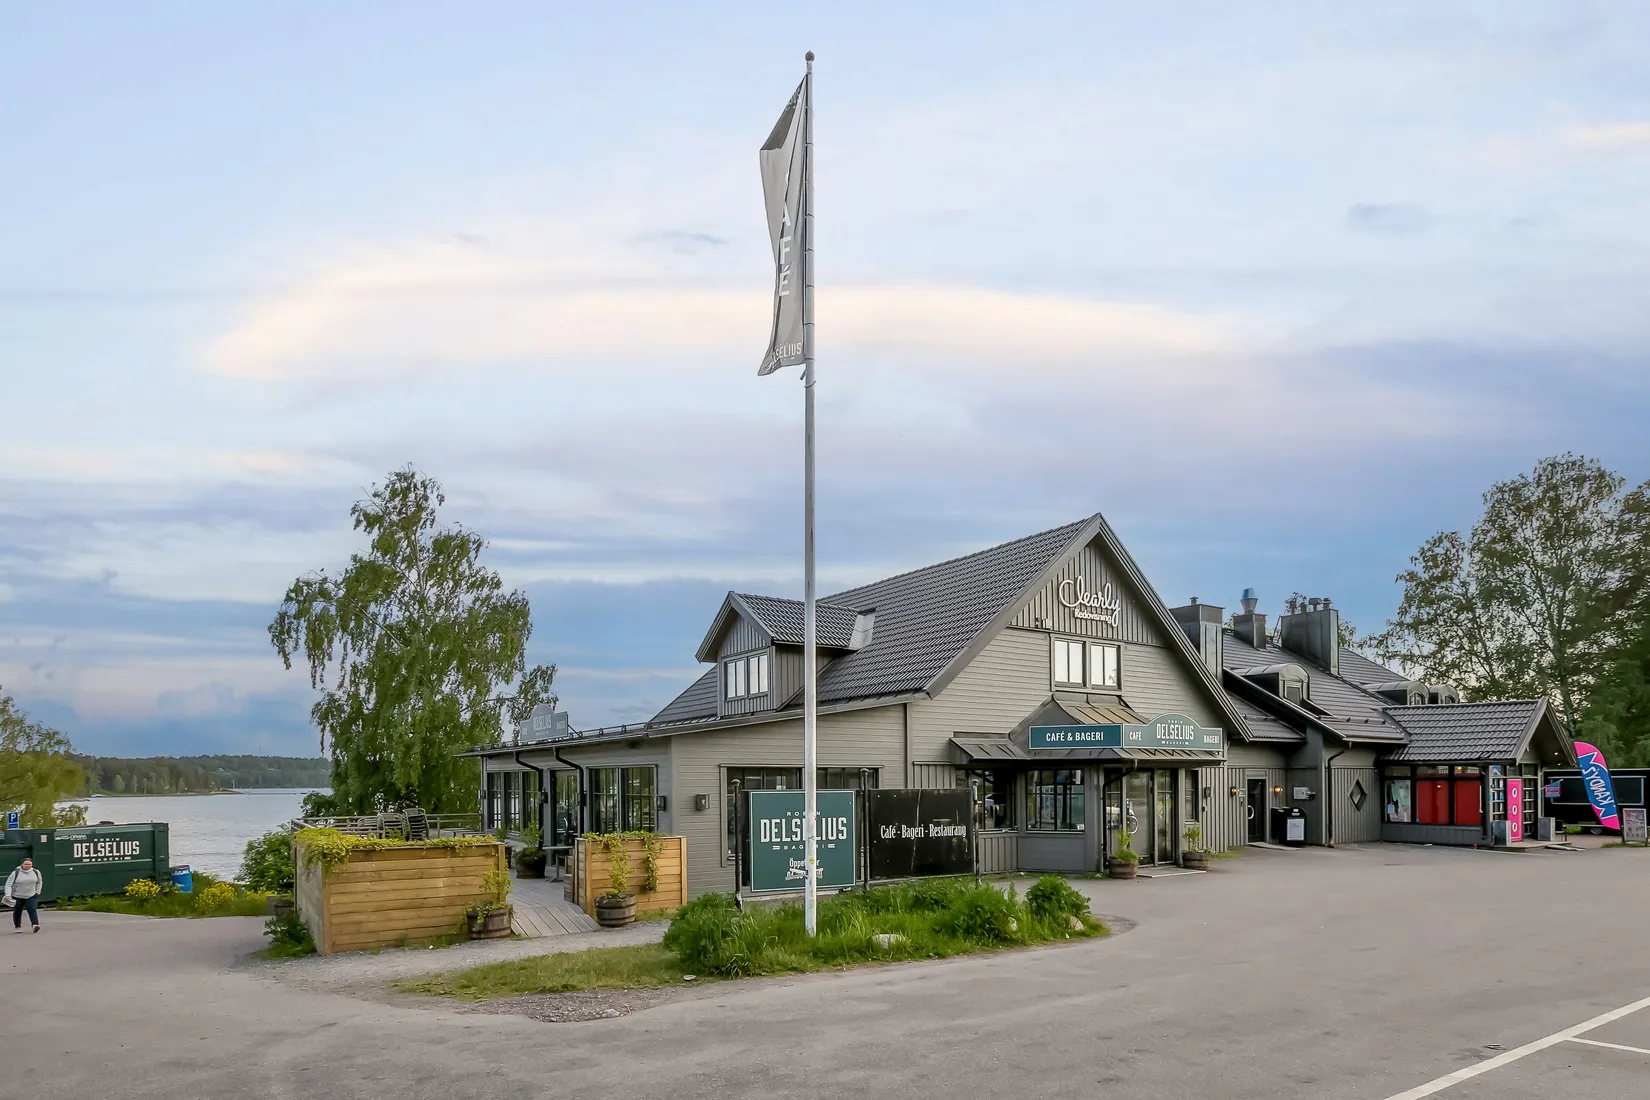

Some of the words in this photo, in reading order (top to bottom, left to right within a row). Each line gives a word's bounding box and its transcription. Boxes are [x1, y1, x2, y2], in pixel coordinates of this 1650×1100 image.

[1059, 575, 1121, 627] Clearly
[1074, 608, 1112, 624] Redovisning
[1045, 730, 1065, 742] CAFÉ
[1067, 732, 1073, 741] &
[1075, 731, 1104, 741] BAGERI
[1129, 730, 1142, 740] CAFÉ
[1156, 723, 1194, 740] DELSELIUS
[1203, 734, 1220, 744] BAGERI
[880, 825, 896, 839] Café
[901, 824, 924, 840] Bageri
[929, 823, 967, 838] Restaurang
[73, 841, 140, 858] DELSELIUS
